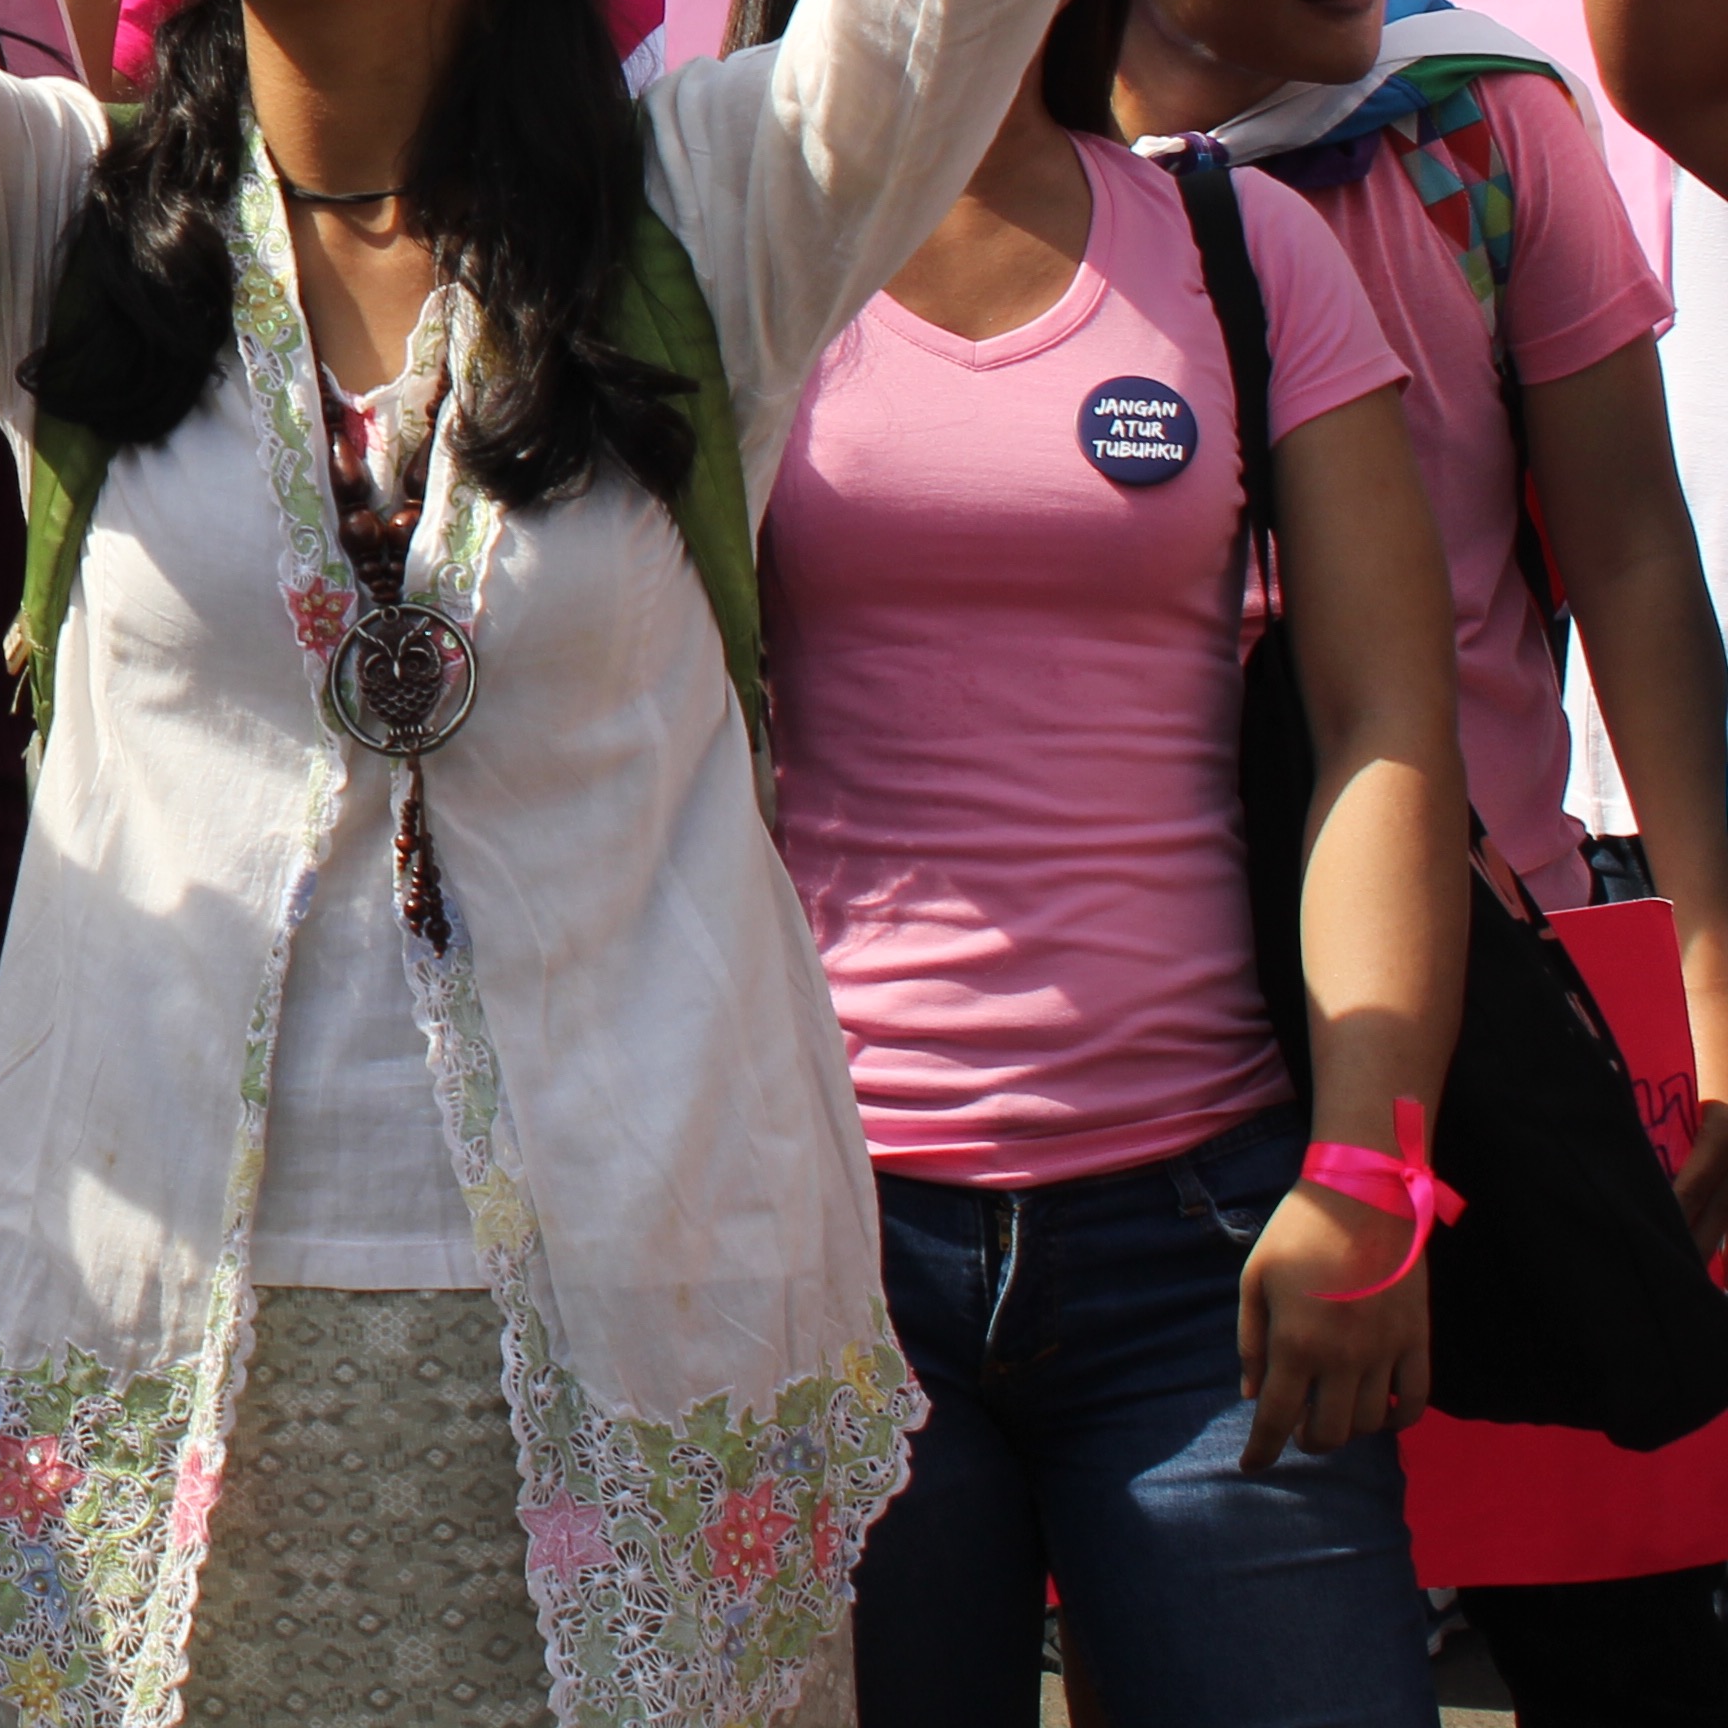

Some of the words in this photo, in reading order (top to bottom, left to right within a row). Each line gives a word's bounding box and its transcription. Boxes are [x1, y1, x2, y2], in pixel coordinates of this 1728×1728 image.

[1094, 398, 1178, 418] JANGAN
[1110, 419, 1165, 440] ATUR
[1092, 439, 1184, 461] TUBUHKU
